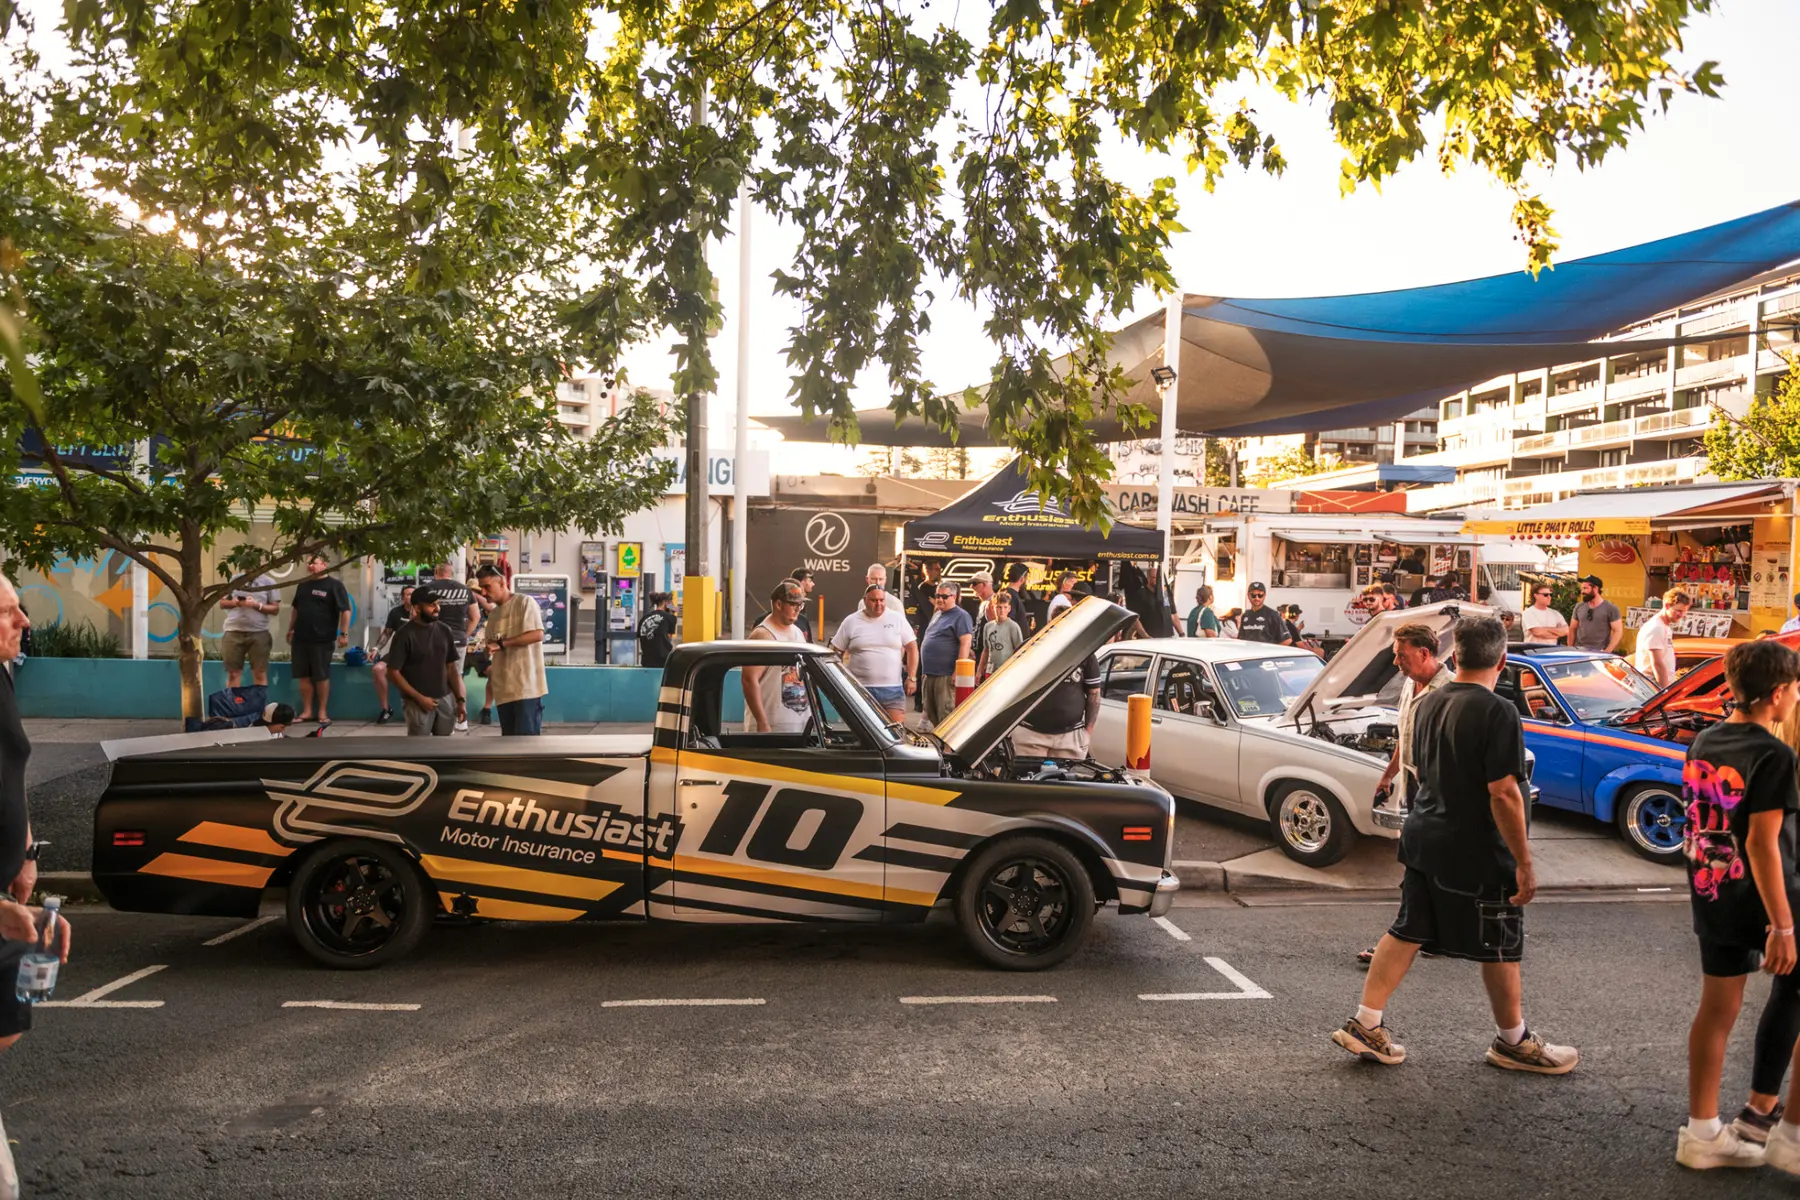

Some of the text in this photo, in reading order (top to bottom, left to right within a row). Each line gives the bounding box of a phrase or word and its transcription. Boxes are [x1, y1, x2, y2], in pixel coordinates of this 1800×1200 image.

[1119, 491, 1151, 512] CAR
[982, 514, 1080, 525] Enthusiast
[1516, 520, 1595, 533] LITTLE PHAT ROLLS
[953, 535, 1013, 546] Enthusiast
[1097, 551, 1159, 559] enthusiast.com.au
[804, 559, 850, 571] WAVES
[447, 788, 674, 853] Enthusiast
[699, 780, 864, 870] 10
[440, 826, 595, 864] Motor Insurance
